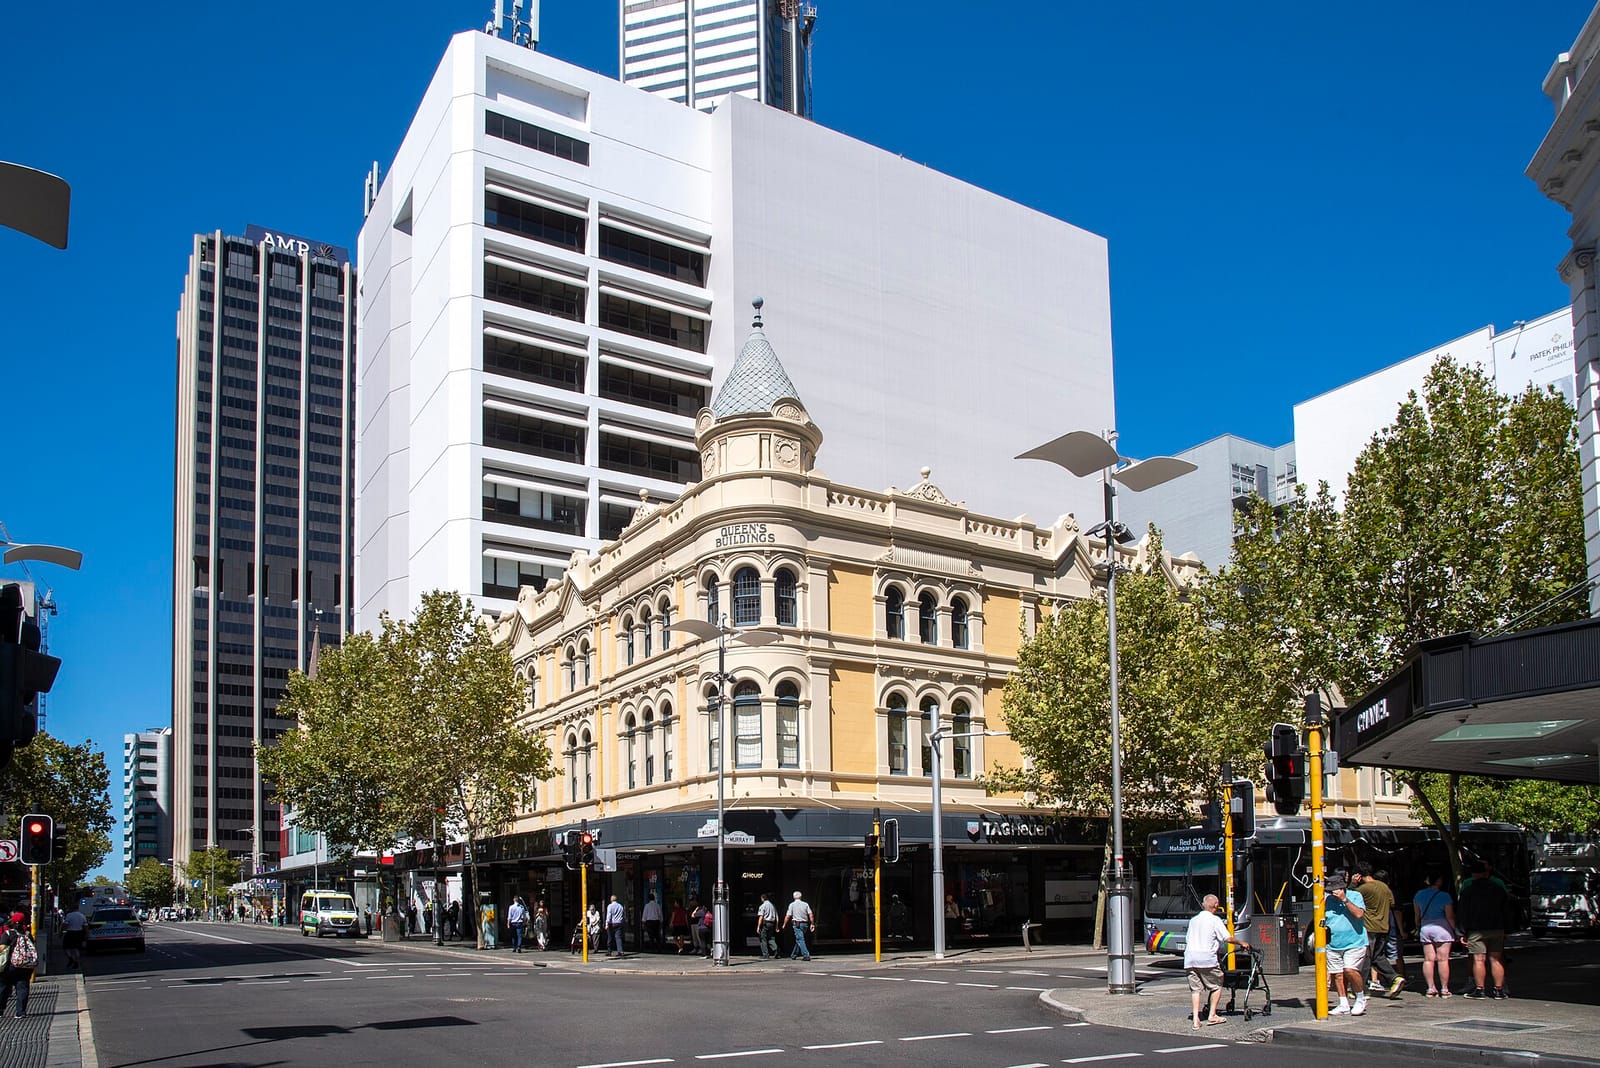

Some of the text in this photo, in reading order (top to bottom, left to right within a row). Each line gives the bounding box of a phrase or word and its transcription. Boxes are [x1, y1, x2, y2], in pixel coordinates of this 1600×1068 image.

[264, 232, 310, 256] AMP
[1529, 340, 1574, 362] PATEK PHILIP
[721, 523, 767, 537] QUEEN'S
[716, 533, 775, 547] BUILDINGS
[1357, 698, 1390, 733] CHANEL
[729, 836, 749, 844] MURRAY
[1179, 838, 1190, 846] Red
